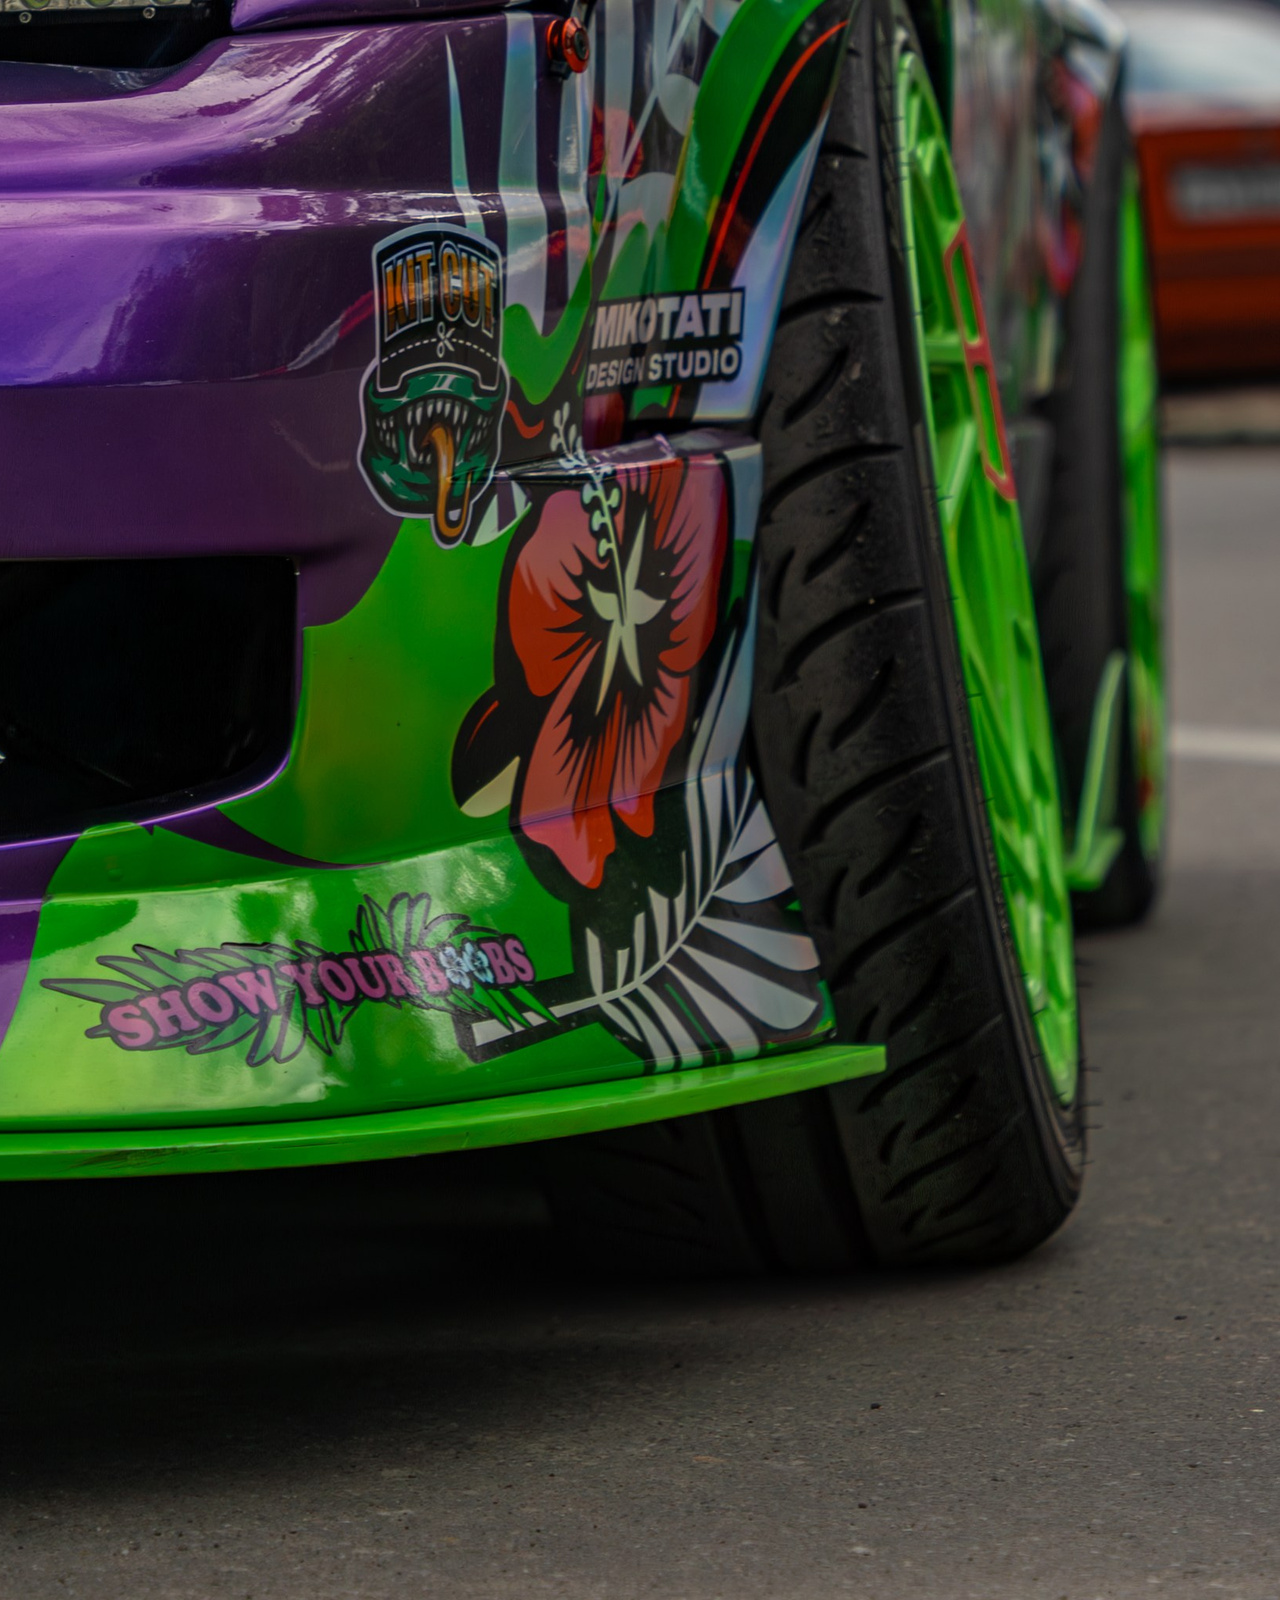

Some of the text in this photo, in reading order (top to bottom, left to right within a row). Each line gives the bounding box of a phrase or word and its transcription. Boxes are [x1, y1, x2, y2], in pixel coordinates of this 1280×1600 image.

[383, 241, 497, 341] KIT CUT
[592, 292, 743, 350] MIKOTATI
[586, 344, 740, 390] DESIGN STUDIO
[108, 968, 278, 1047] SHOW
[279, 953, 421, 1005] YOUR
